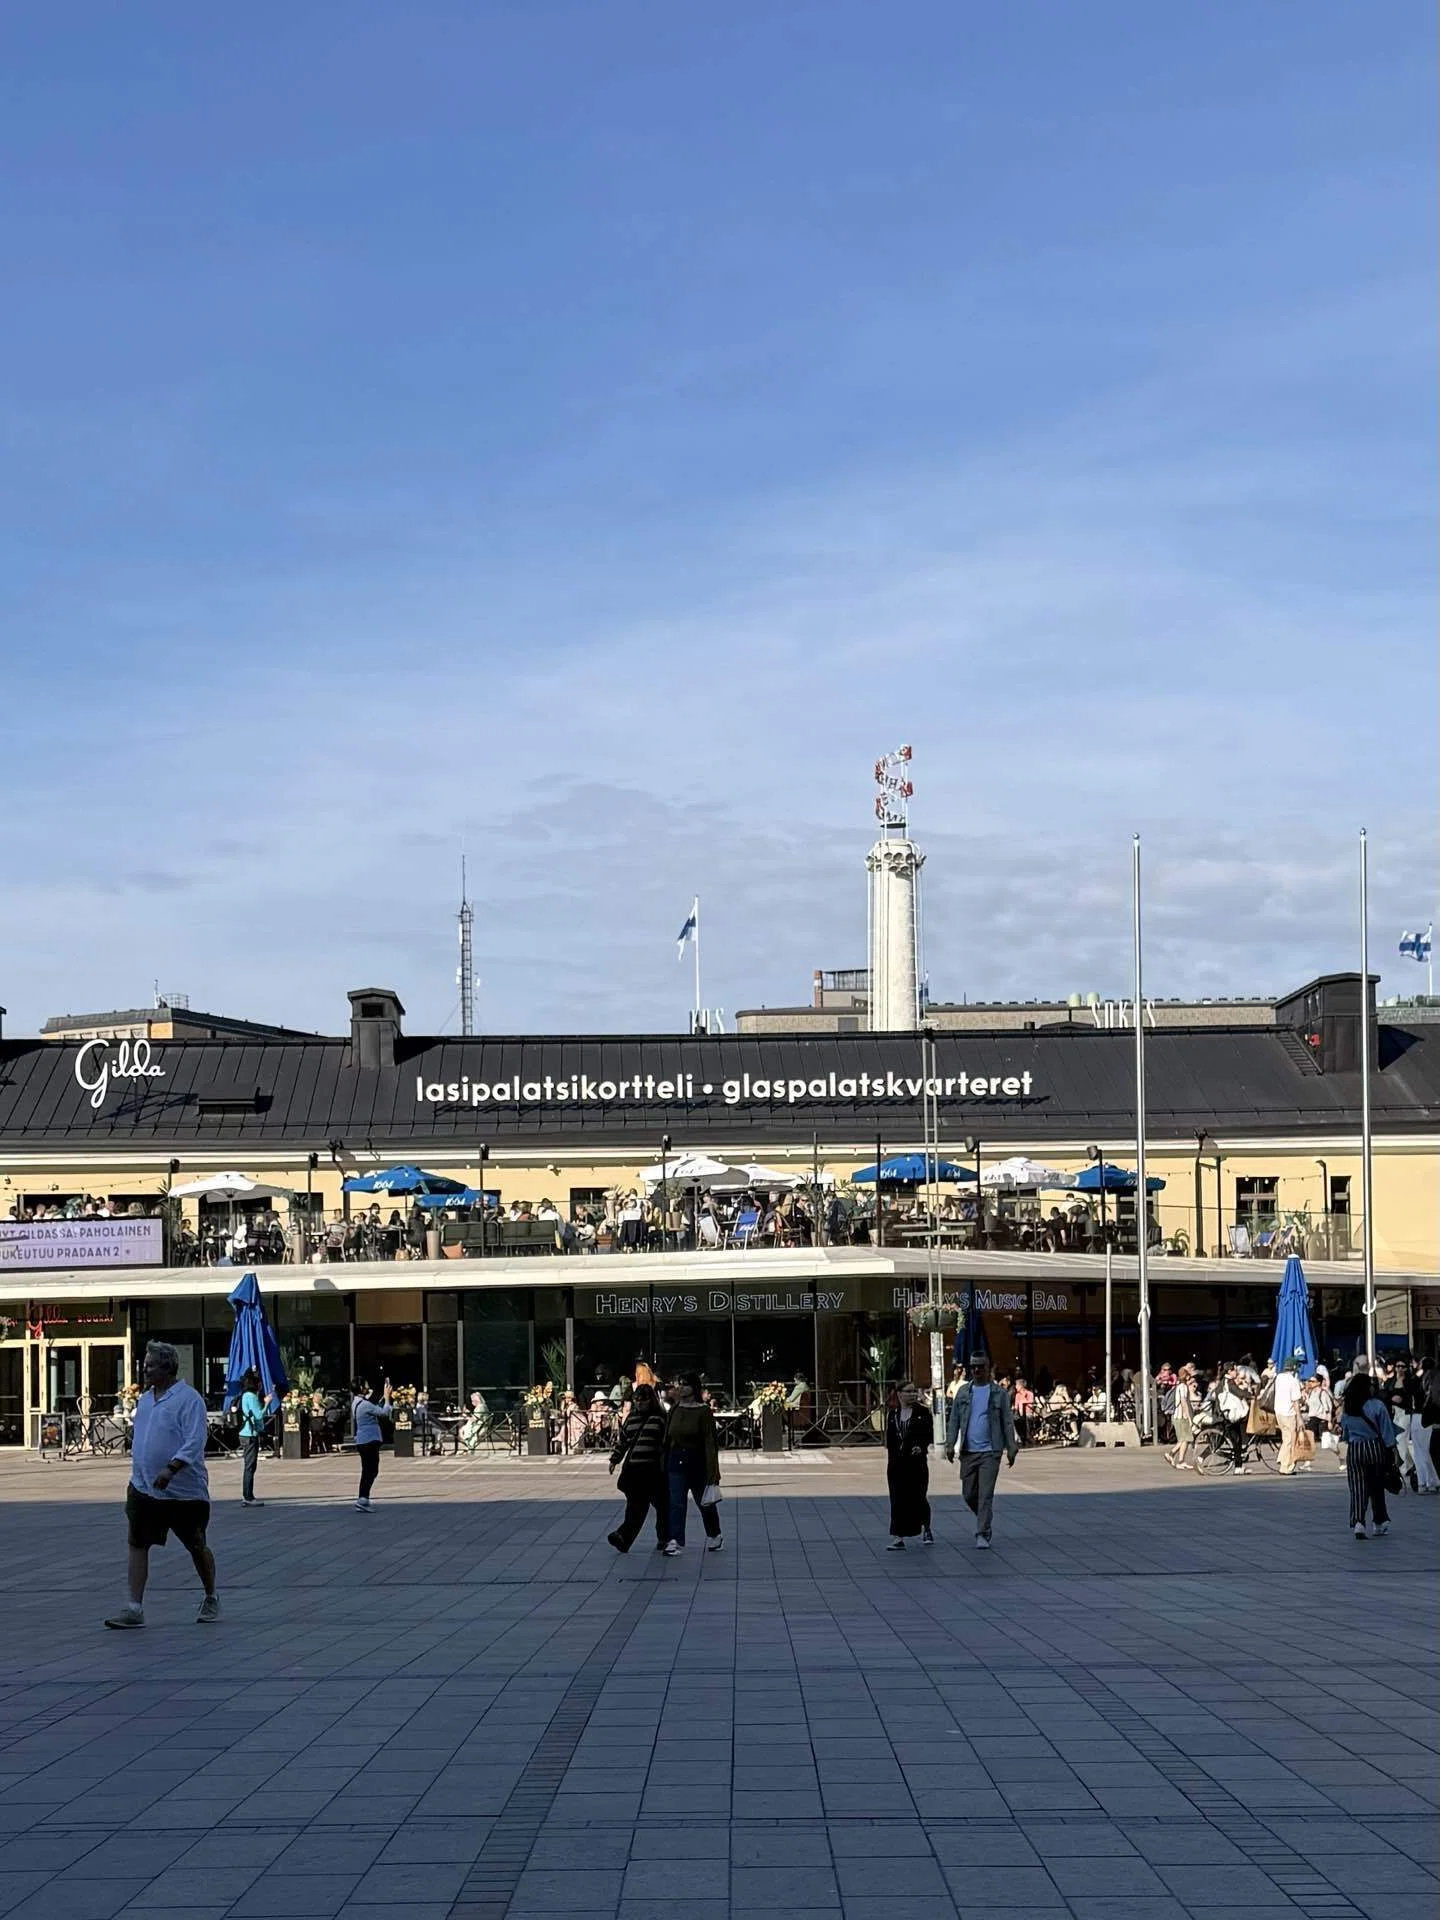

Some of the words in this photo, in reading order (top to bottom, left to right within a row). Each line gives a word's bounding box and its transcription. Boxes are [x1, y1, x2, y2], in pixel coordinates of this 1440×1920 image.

[75, 1039, 166, 1109] Gilda
[416, 1074, 693, 1106] lasipalatsikortteli
[722, 1070, 1033, 1103] glaspalatskvarteret
[0, 1230, 14, 1238] YT
[80, 1225, 150, 1238] PAHOLAINEN
[0, 1248, 54, 1260] UKEUTUU
[57, 1247, 110, 1258] PRADAAN
[114, 1246, 120, 1256] 2
